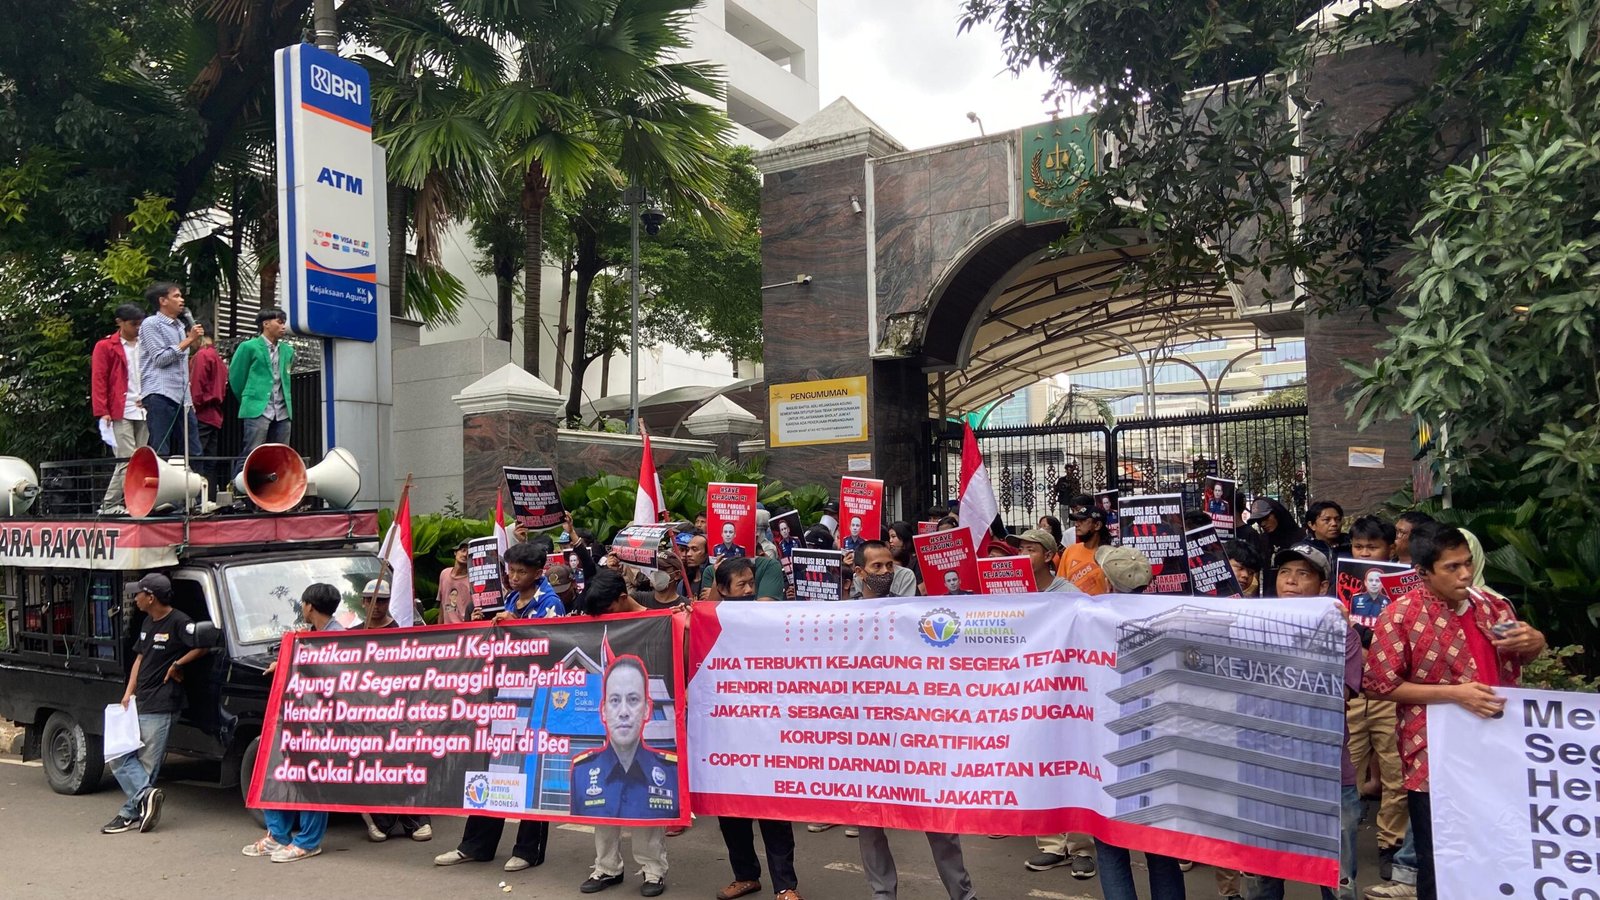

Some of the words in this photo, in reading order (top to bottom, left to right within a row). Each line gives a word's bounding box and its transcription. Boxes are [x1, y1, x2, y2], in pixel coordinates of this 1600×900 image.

[331, 73, 362, 106] BRI
[317, 166, 362, 196] ATM
[341, 236, 353, 245] VISA
[309, 284, 345, 299] Kejaksaan
[346, 292, 368, 305] Agung
[357, 287, 367, 295] KK
[790, 388, 848, 401] PENGUMUMAN
[1119, 507, 1144, 517] REVOLUSI
[1145, 505, 1158, 515] BEA
[1159, 505, 1180, 515] CUKAI
[1133, 514, 1162, 525] JAKARTA
[929, 532, 953, 544] #SAVE
[1122, 536, 1135, 544] COPOT
[1155, 534, 1181, 543] DARNADI
[1197, 533, 1217, 547] CUKAI
[0, 529, 34, 558] ARA
[40, 529, 120, 560] RAKYAT
[920, 541, 955, 554] KEJAGUNG
[1158, 542, 1180, 550] KEPALA
[1150, 550, 1167, 558] CUKAI
[1168, 549, 1184, 557] DJBC
[793, 556, 815, 565] REVOLUSI
[815, 557, 825, 565] BEA
[825, 559, 840, 567] CUKAI
[992, 561, 1013, 570] #SAVE
[805, 564, 827, 573] JAKARTA
[1207, 566, 1227, 578] KEPALA
[983, 570, 1015, 580] KEJAGUNG
[1155, 572, 1188, 584] JAKARTA
[1217, 571, 1232, 582] DJBC
[1400, 574, 1420, 585] #SA
[1158, 582, 1183, 593] MAFIA
[965, 609, 1025, 619] HIMPUNAN
[964, 618, 1006, 627] AKTIVIS
[963, 627, 1016, 635] MILENIAL
[964, 635, 1027, 644] INDONESIA
[364, 637, 463, 662] Pembiaran!
[465, 633, 549, 661] Kejaksaan
[707, 657, 741, 670] JIKA
[744, 656, 822, 670] TERBUKTI
[826, 655, 922, 670] KEJAGUNG
[926, 656, 945, 670] RI
[949, 656, 1020, 671] SEGERA
[1023, 648, 1117, 668] TETAPKAN
[286, 672, 336, 698] Agung
[338, 670, 360, 692] RI
[359, 669, 422, 696] Segera
[423, 664, 494, 695] Panggil
[495, 665, 525, 688] dan
[528, 664, 586, 687] Periksa
[1212, 653, 1344, 698] KEJAKSAAN
[716, 680, 772, 694] HENDRI
[776, 680, 848, 694] DARNADI
[852, 680, 919, 695] KEPALA
[923, 681, 962, 697] BEA
[965, 682, 1020, 697] CUKAI
[1023, 676, 1088, 694] KANWIL
[574, 689, 589, 697] Bea
[574, 697, 594, 706] Cukai
[283, 700, 334, 722] Hendri
[335, 698, 406, 722] Darnadi
[407, 700, 449, 721] atas
[451, 698, 517, 726] Dugaan
[710, 704, 781, 718] JAKARTA
[787, 705, 859, 720] SEBAGAI
[862, 706, 972, 723] TERSANGKA
[975, 707, 1018, 723] ATAS
[1021, 703, 1094, 722] DUGAAN
[1522, 699, 1600, 731] Me
[280, 729, 383, 758] Perlindungan
[385, 728, 471, 759] Jaringan
[474, 728, 516, 759] Ilegal
[518, 727, 534, 753] di
[537, 729, 570, 754] Bea
[780, 730, 853, 745] KORUPSI
[856, 731, 891, 746] DAN
[899, 733, 1010, 750] GRATIFIKASI
[274, 756, 306, 782] dan
[307, 758, 354, 783] Cukai
[354, 758, 427, 784] Jakarta
[708, 752, 761, 768] COPOT
[764, 754, 824, 770] HENDRI
[828, 757, 900, 774] DARNADI
[904, 760, 947, 776] DARI
[950, 762, 1034, 778] JABATAN
[1039, 760, 1102, 782] KEPALA
[1527, 768, 1600, 802] He
[774, 780, 807, 795] BEA
[810, 782, 862, 798] CUKAI
[866, 784, 932, 803] KANWIL
[934, 789, 1019, 806] JAKARTA
[490, 800, 519, 808] INDONESIA
[649, 797, 673, 805] CUSTOMS
[1529, 803, 1600, 838] Ko
[1531, 839, 1600, 875] Pe
